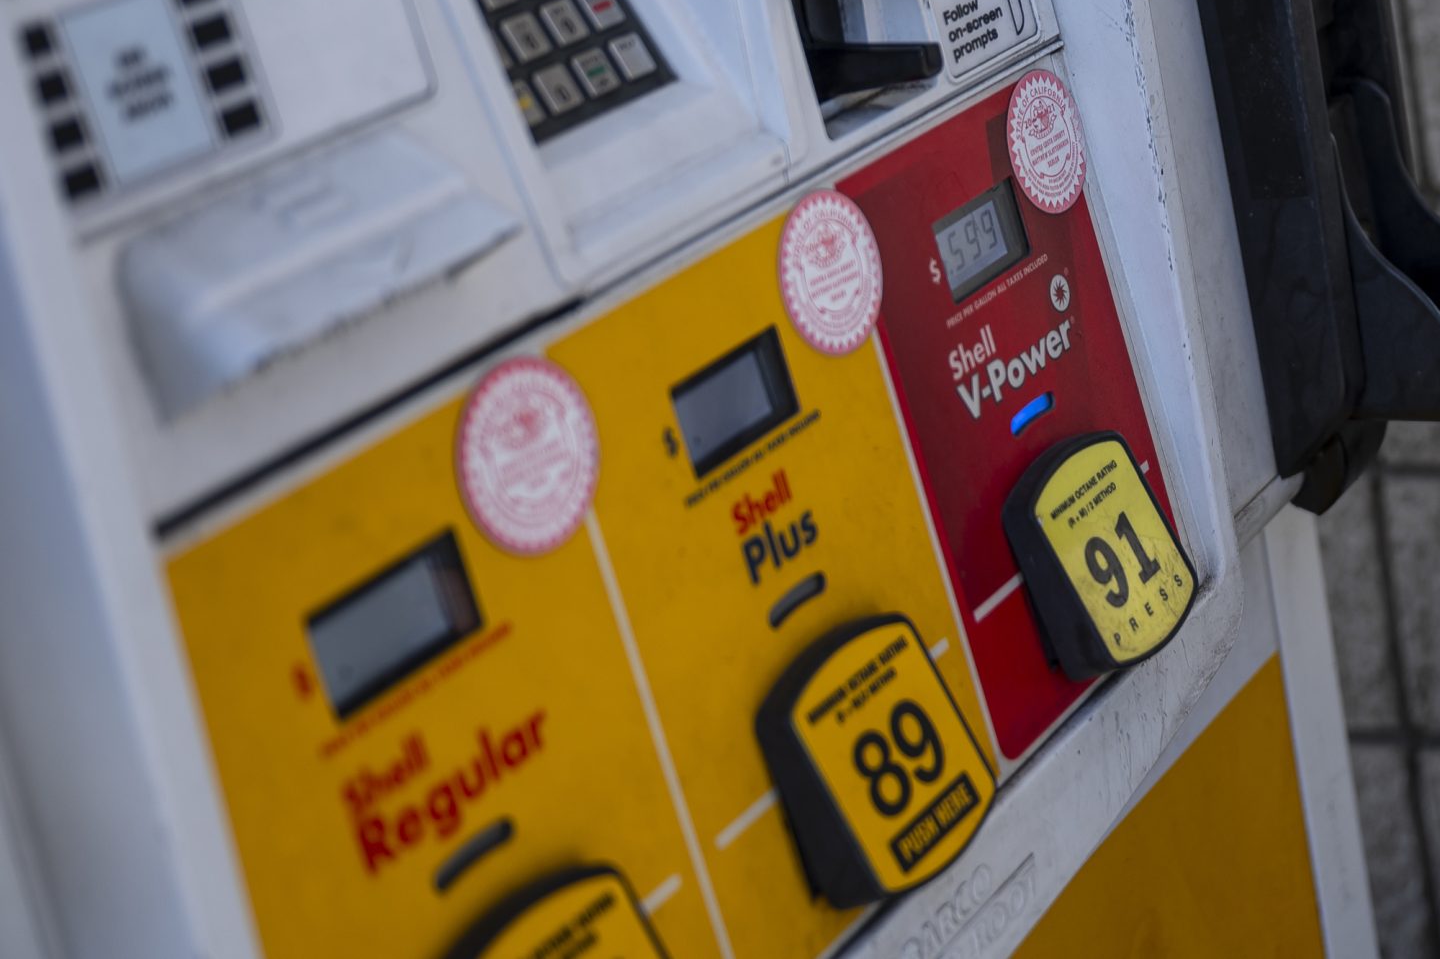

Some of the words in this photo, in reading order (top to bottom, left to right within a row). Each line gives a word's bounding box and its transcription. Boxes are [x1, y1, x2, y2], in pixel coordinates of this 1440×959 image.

[943, 0, 979, 26] Follow
[948, 6, 1003, 43] on-screen
[953, 27, 999, 63] prompts
[1022, 94, 1031, 108] OF
[1030, 86, 1066, 113] CALIFORNIA
[929, 257, 941, 285] $
[963, 304, 974, 318] PER
[974, 289, 997, 310] GALLON
[997, 281, 1007, 294] ALL
[1006, 270, 1023, 287] TAXES
[1023, 254, 1048, 276] INCLUDED
[948, 323, 997, 381] Shell
[956, 319, 1071, 420] V-Power
[731, 468, 793, 538] Shell
[1051, 494, 1076, 520] MINIMUM
[1075, 476, 1098, 499] OCTANE
[1096, 459, 1117, 481] RATING
[1093, 482, 1116, 506] METHOD
[741, 508, 819, 586] Plus
[1085, 511, 1161, 608] 91
[853, 699, 946, 818] 89
[355, 708, 548, 878] Regular
